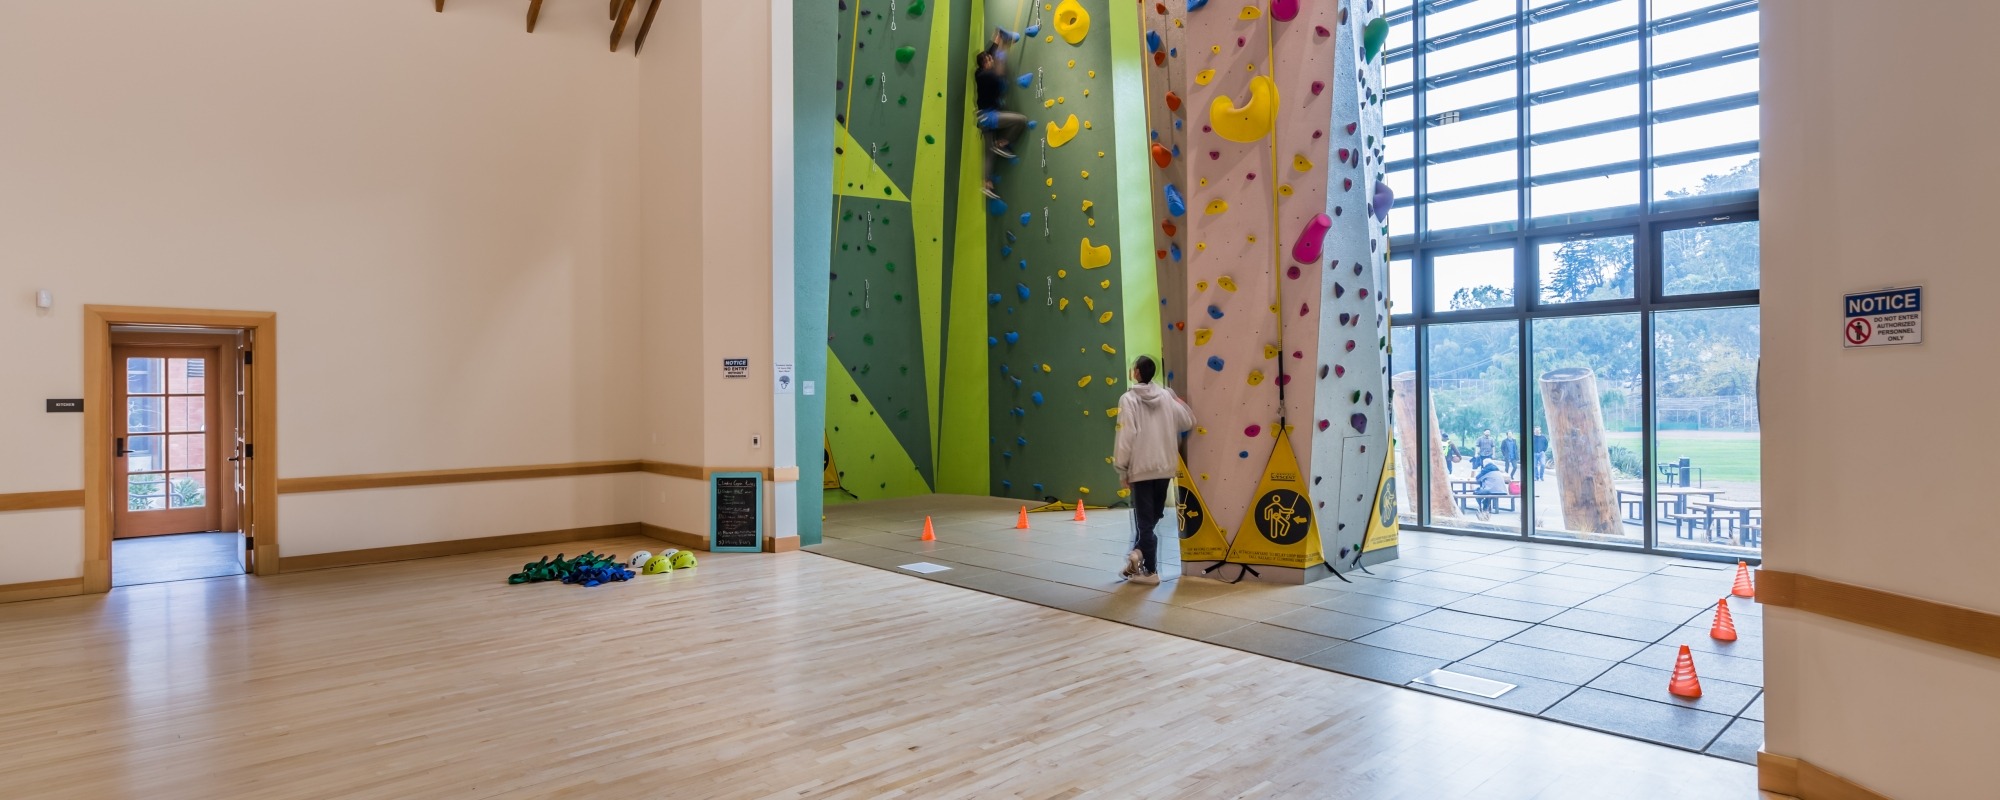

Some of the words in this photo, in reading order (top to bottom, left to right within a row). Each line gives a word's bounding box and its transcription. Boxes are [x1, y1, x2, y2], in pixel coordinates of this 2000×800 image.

[1849, 293, 1917, 313] NOTICE
[1898, 313, 1919, 321] ENTER
[1876, 321, 1916, 329] AUTHORIZED
